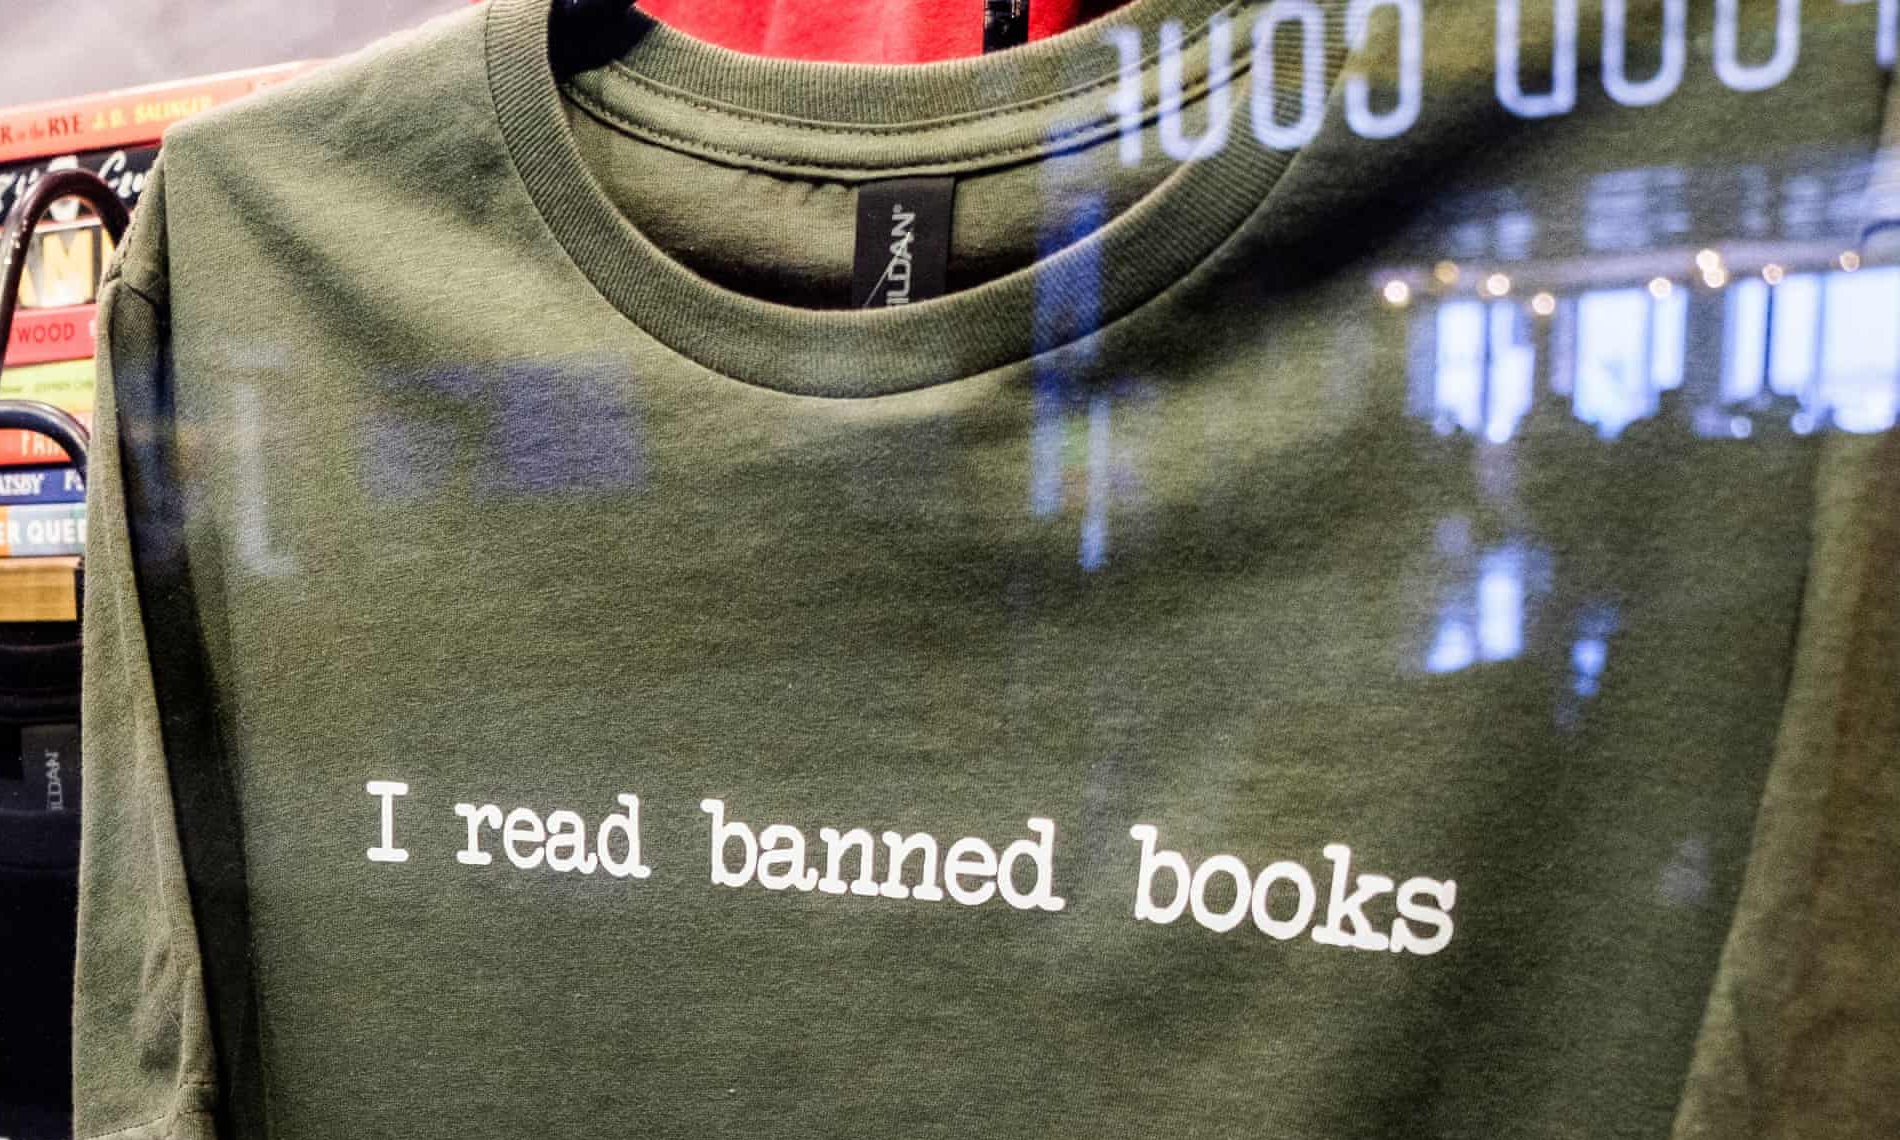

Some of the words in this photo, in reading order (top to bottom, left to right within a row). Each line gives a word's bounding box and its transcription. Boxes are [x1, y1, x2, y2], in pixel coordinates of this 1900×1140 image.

[47, 114, 83, 137] RYE
[886, 212, 916, 305] ILDAN
[365, 780, 410, 864] I
[454, 795, 651, 880] read
[700, 799, 1066, 914] banned
[1131, 824, 1457, 957] books
